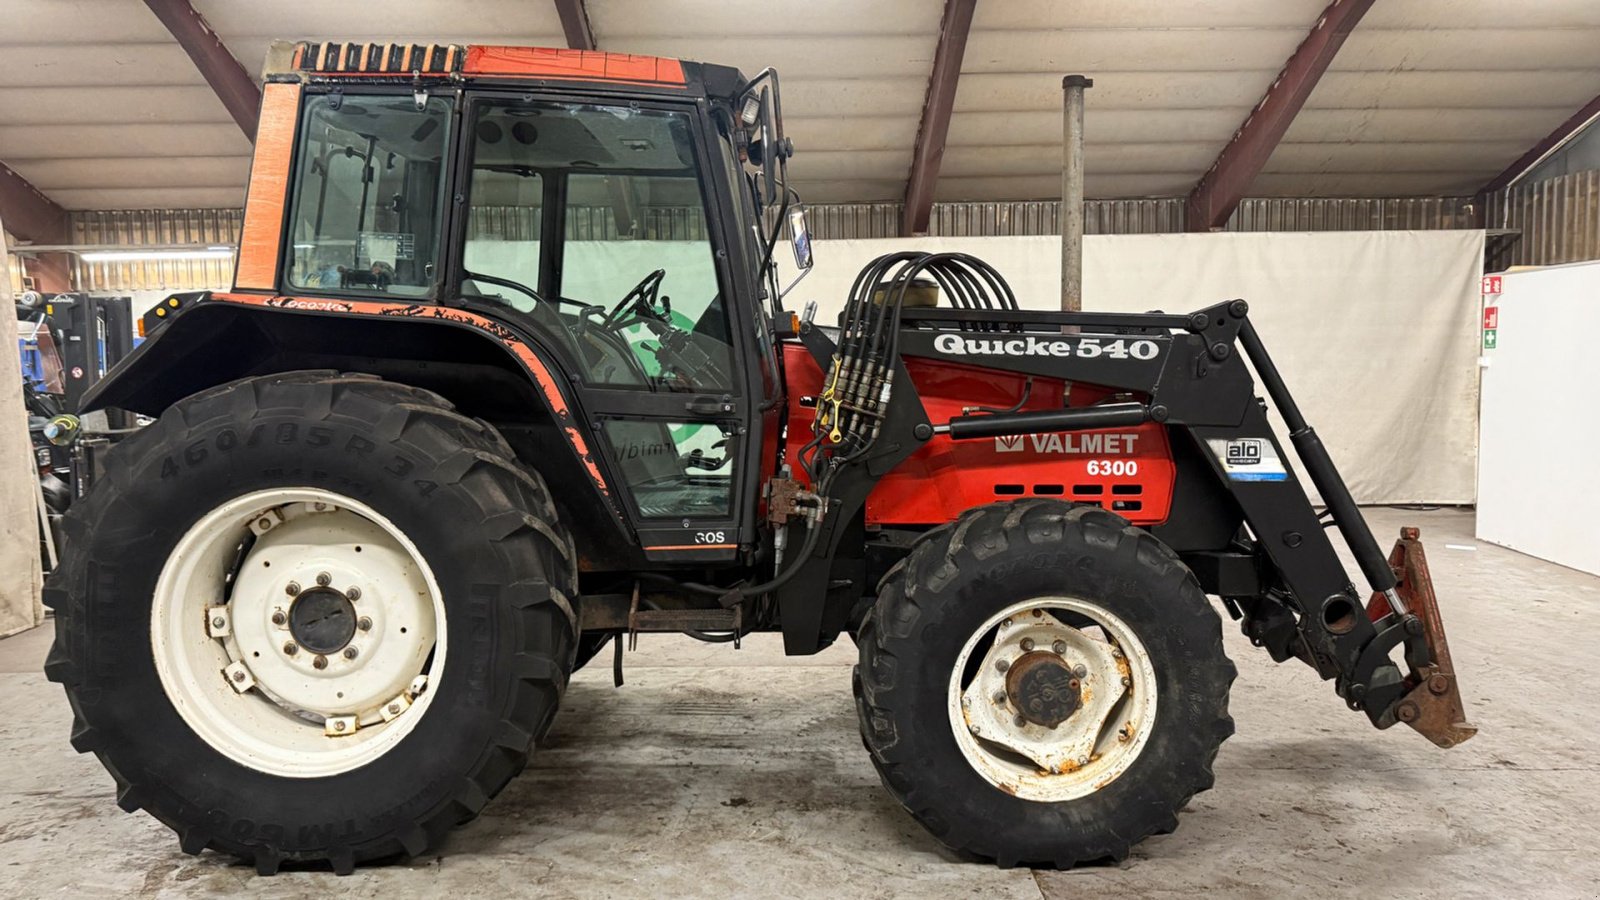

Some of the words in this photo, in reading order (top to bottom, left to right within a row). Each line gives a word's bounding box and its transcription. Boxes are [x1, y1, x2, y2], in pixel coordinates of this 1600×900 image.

[934, 333, 1071, 356] Quicke
[1076, 338, 1159, 360] 540
[160, 422, 335, 480] 460/85
[1030, 434, 1139, 454] VALMET
[1229, 442, 1258, 457] alo
[1087, 460, 1138, 476] 6300
